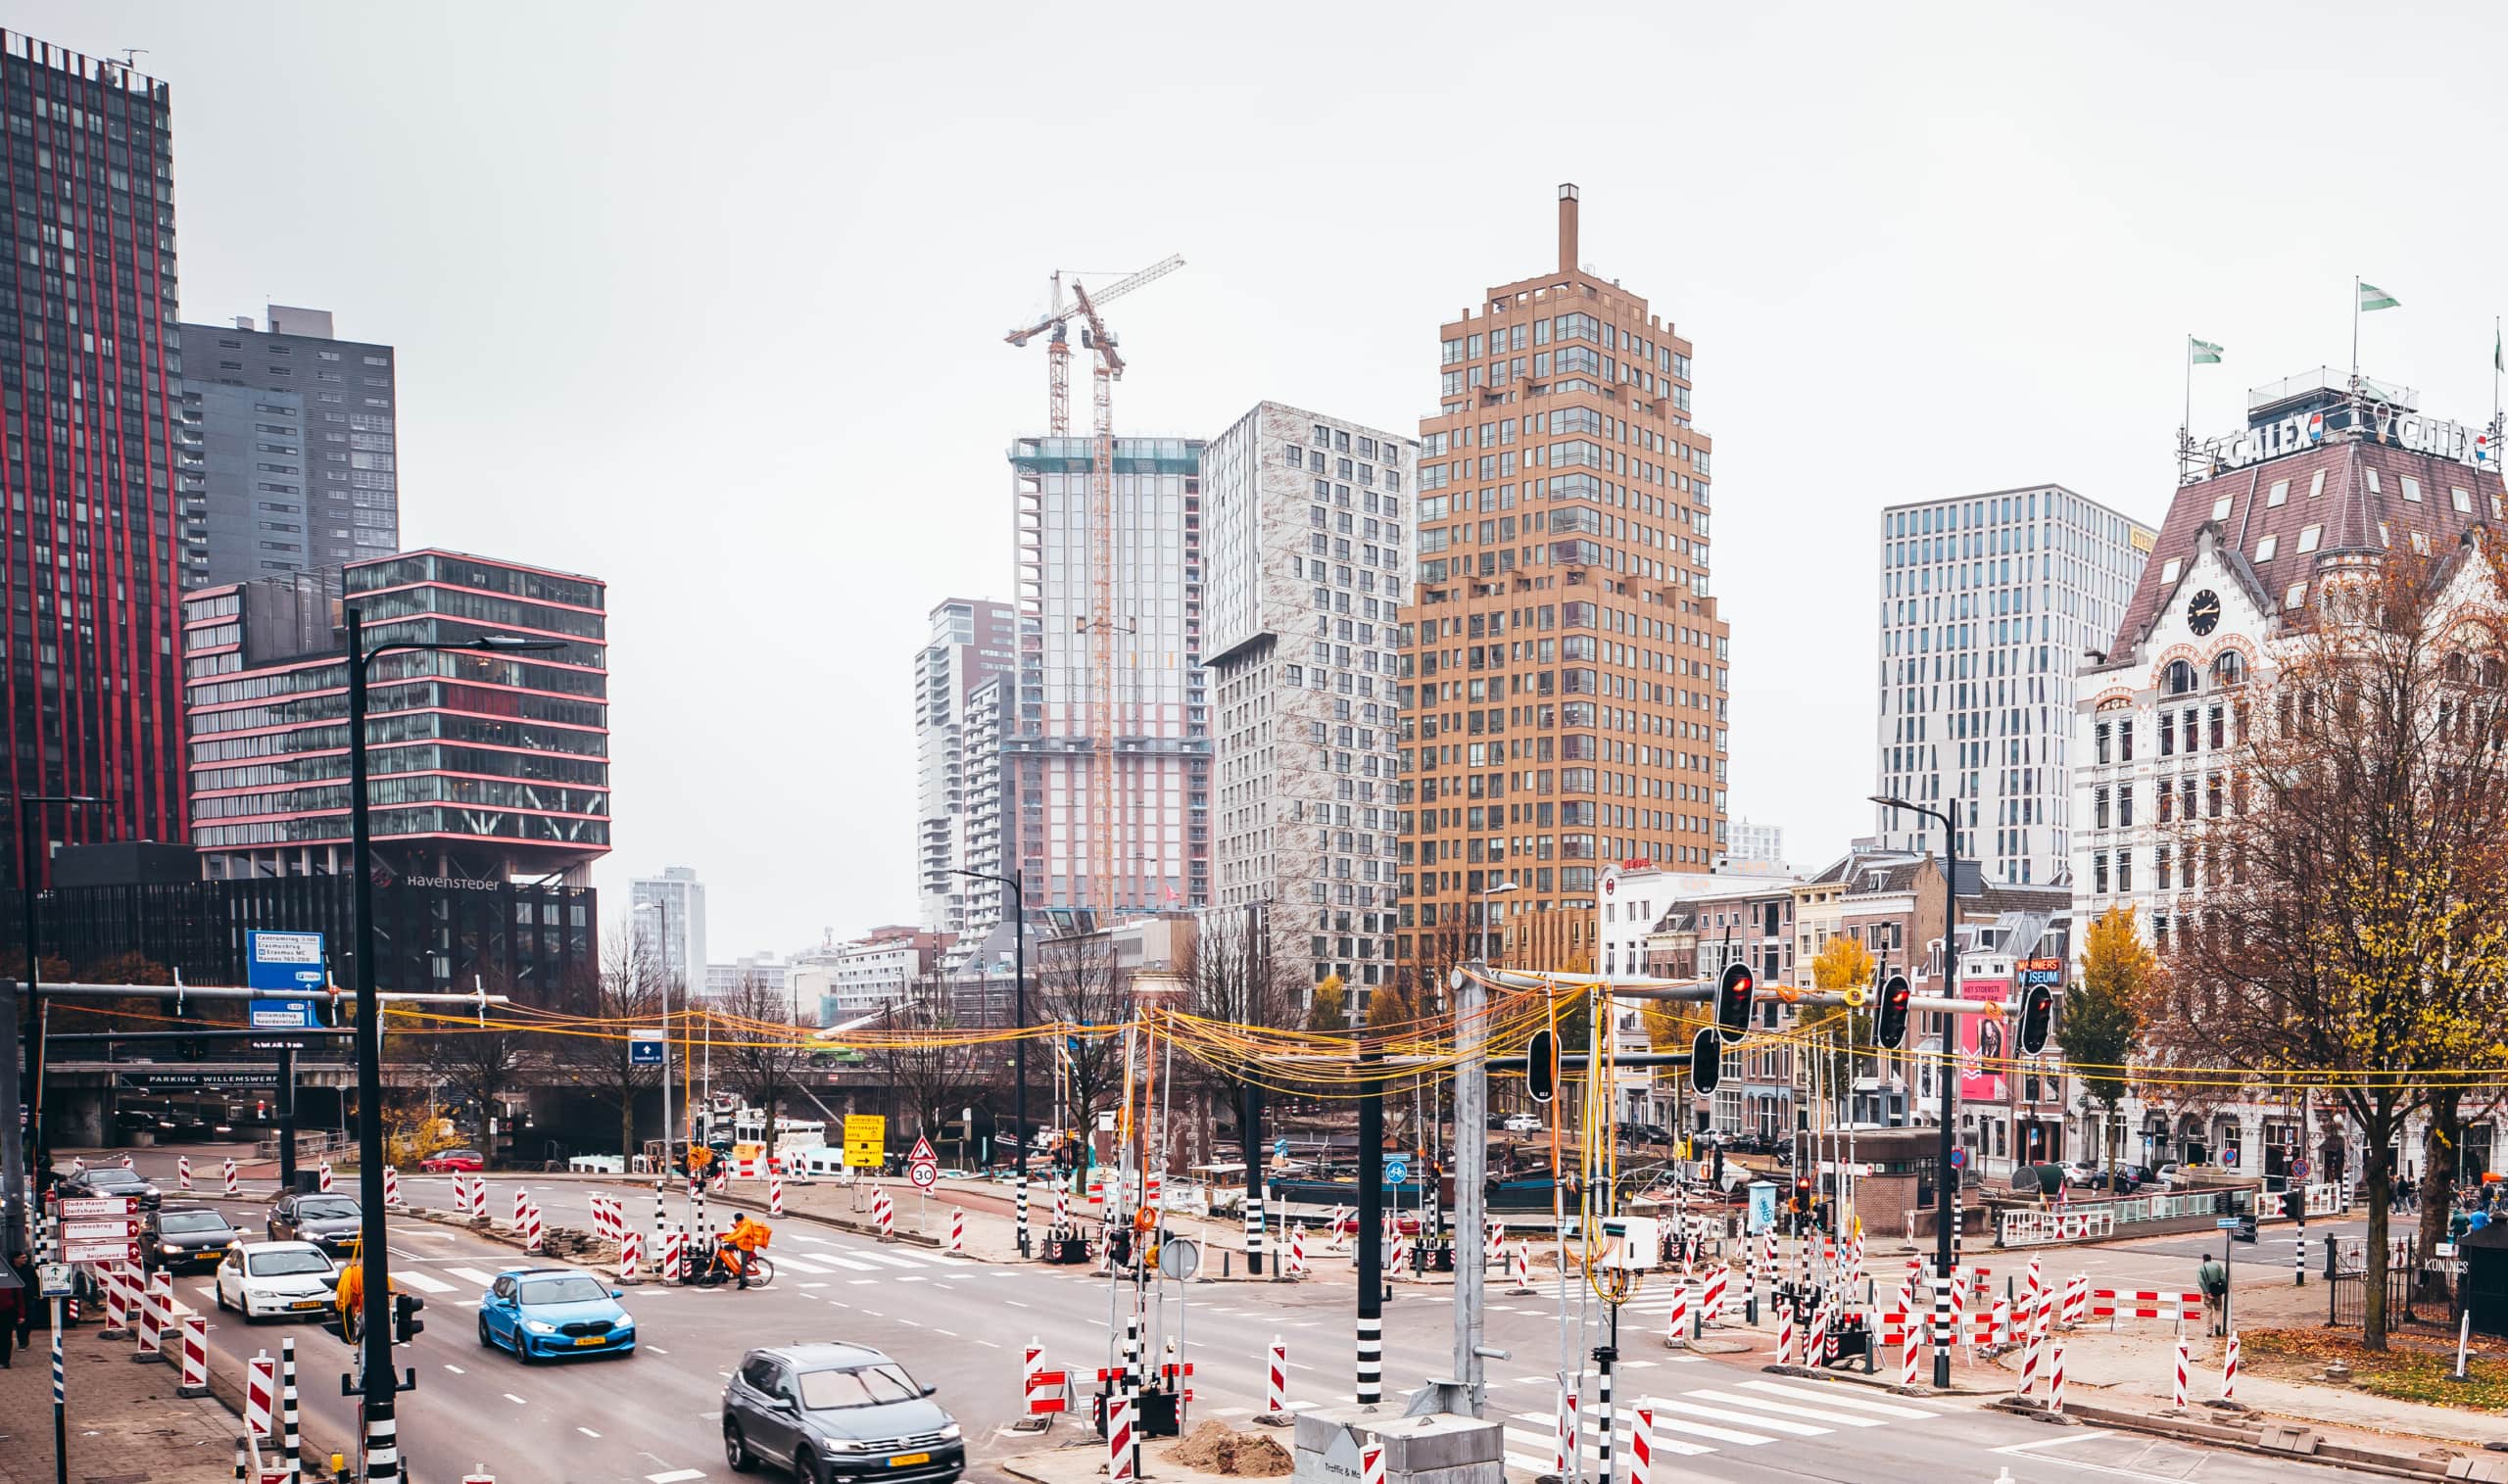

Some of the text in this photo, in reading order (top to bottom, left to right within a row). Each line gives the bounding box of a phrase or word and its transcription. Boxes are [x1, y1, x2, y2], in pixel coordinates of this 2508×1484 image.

[2226, 411, 2314, 467] CALEX
[2397, 412, 2479, 463] CALEX
[915, 1171, 933, 1180] 30
[2424, 1258, 2469, 1274] KONINGS
[1325, 1462, 1343, 1475] Traffic
[1344, 1467, 1350, 1476] &
